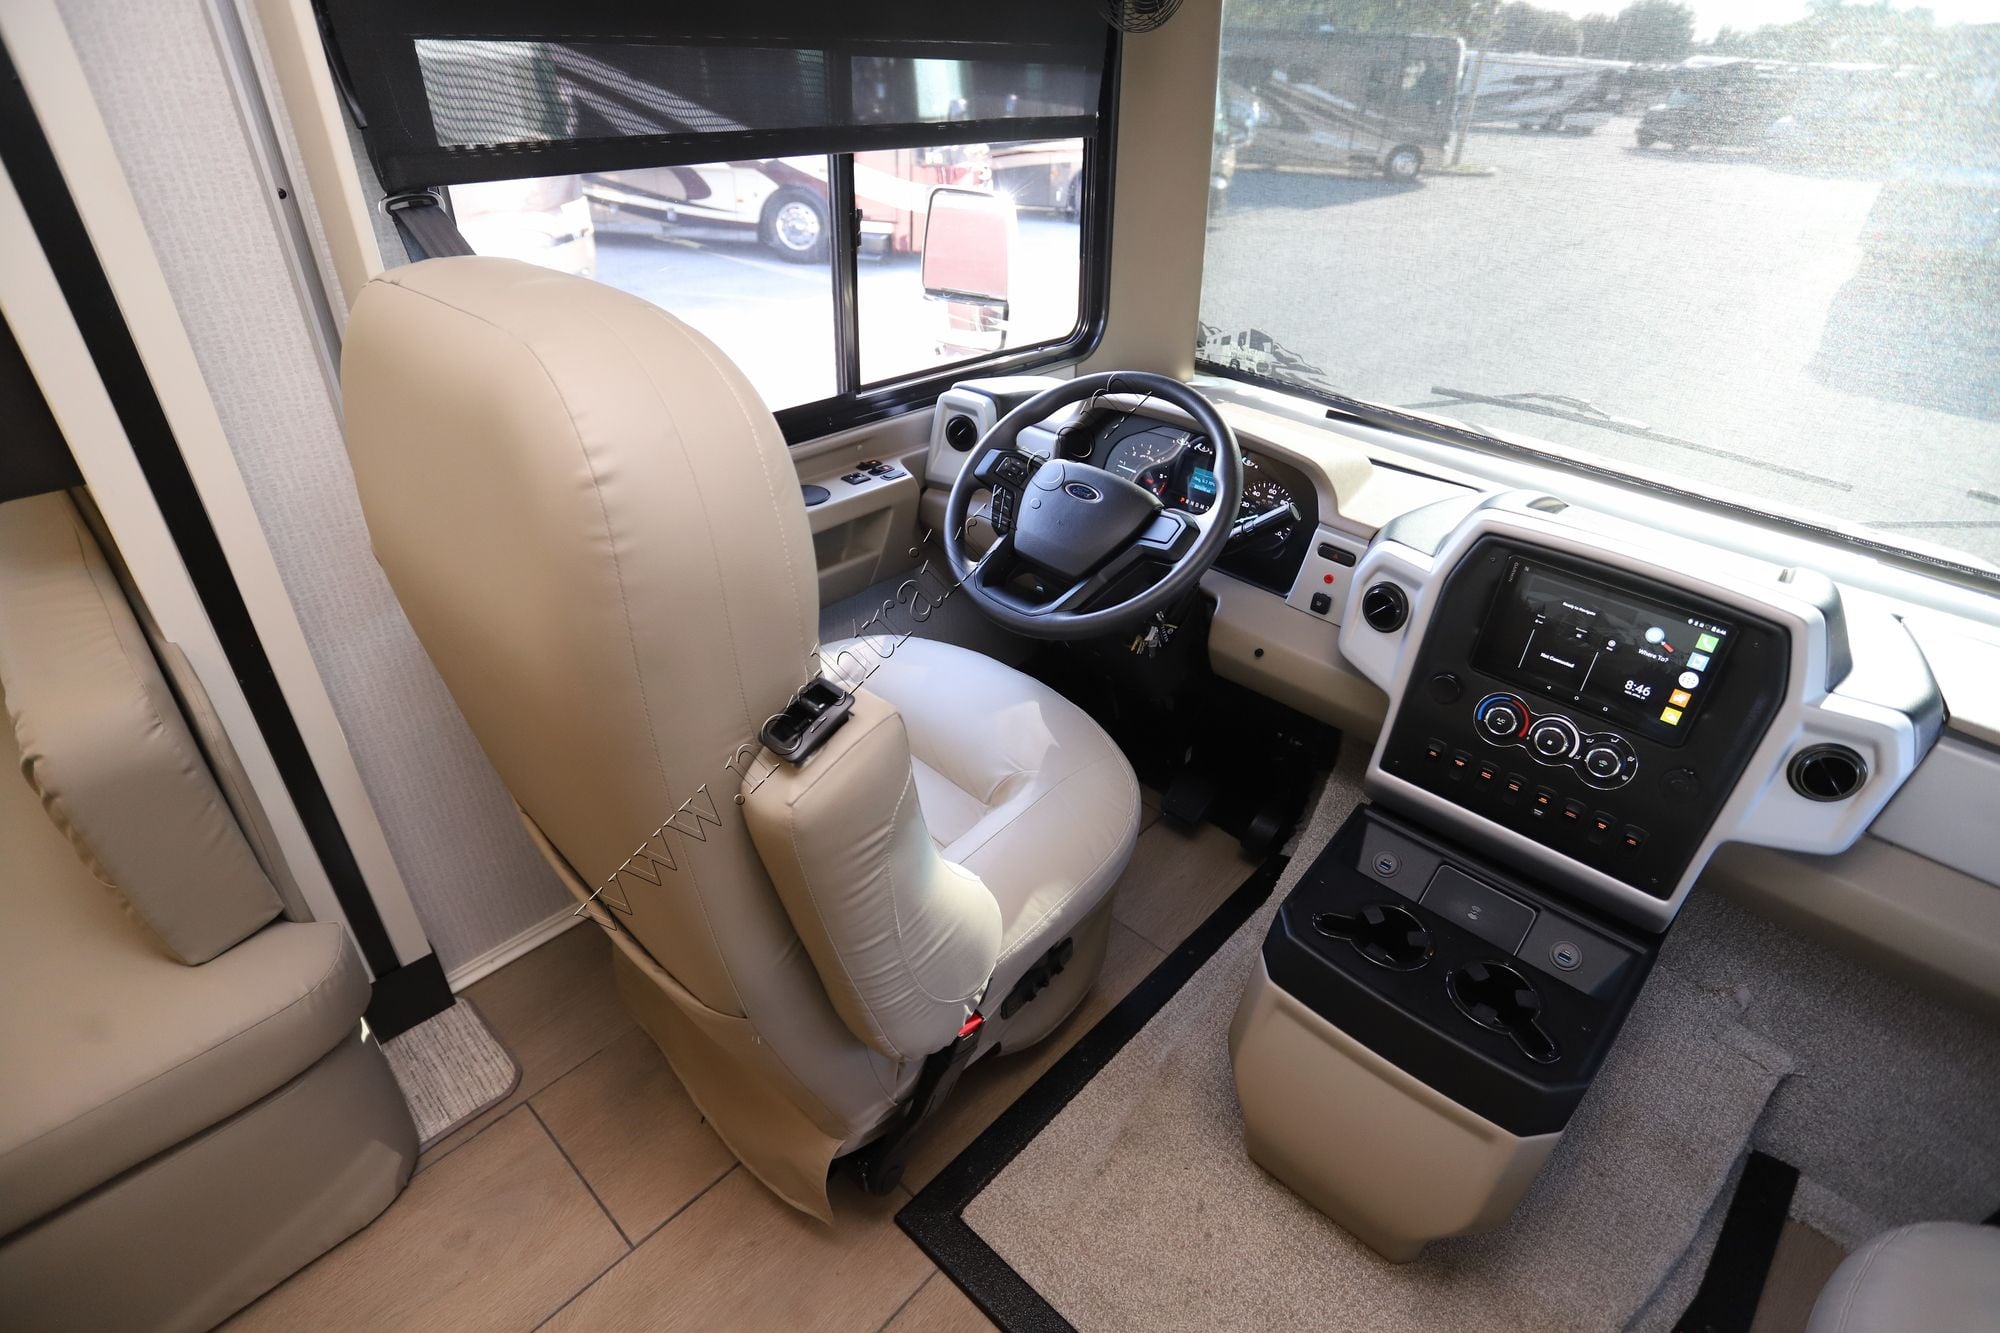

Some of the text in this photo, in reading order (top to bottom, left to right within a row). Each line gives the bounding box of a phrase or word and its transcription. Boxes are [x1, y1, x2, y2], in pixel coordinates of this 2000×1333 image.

[1638, 648, 1669, 663] Where To?
[1624, 679, 1651, 697] 8:46
